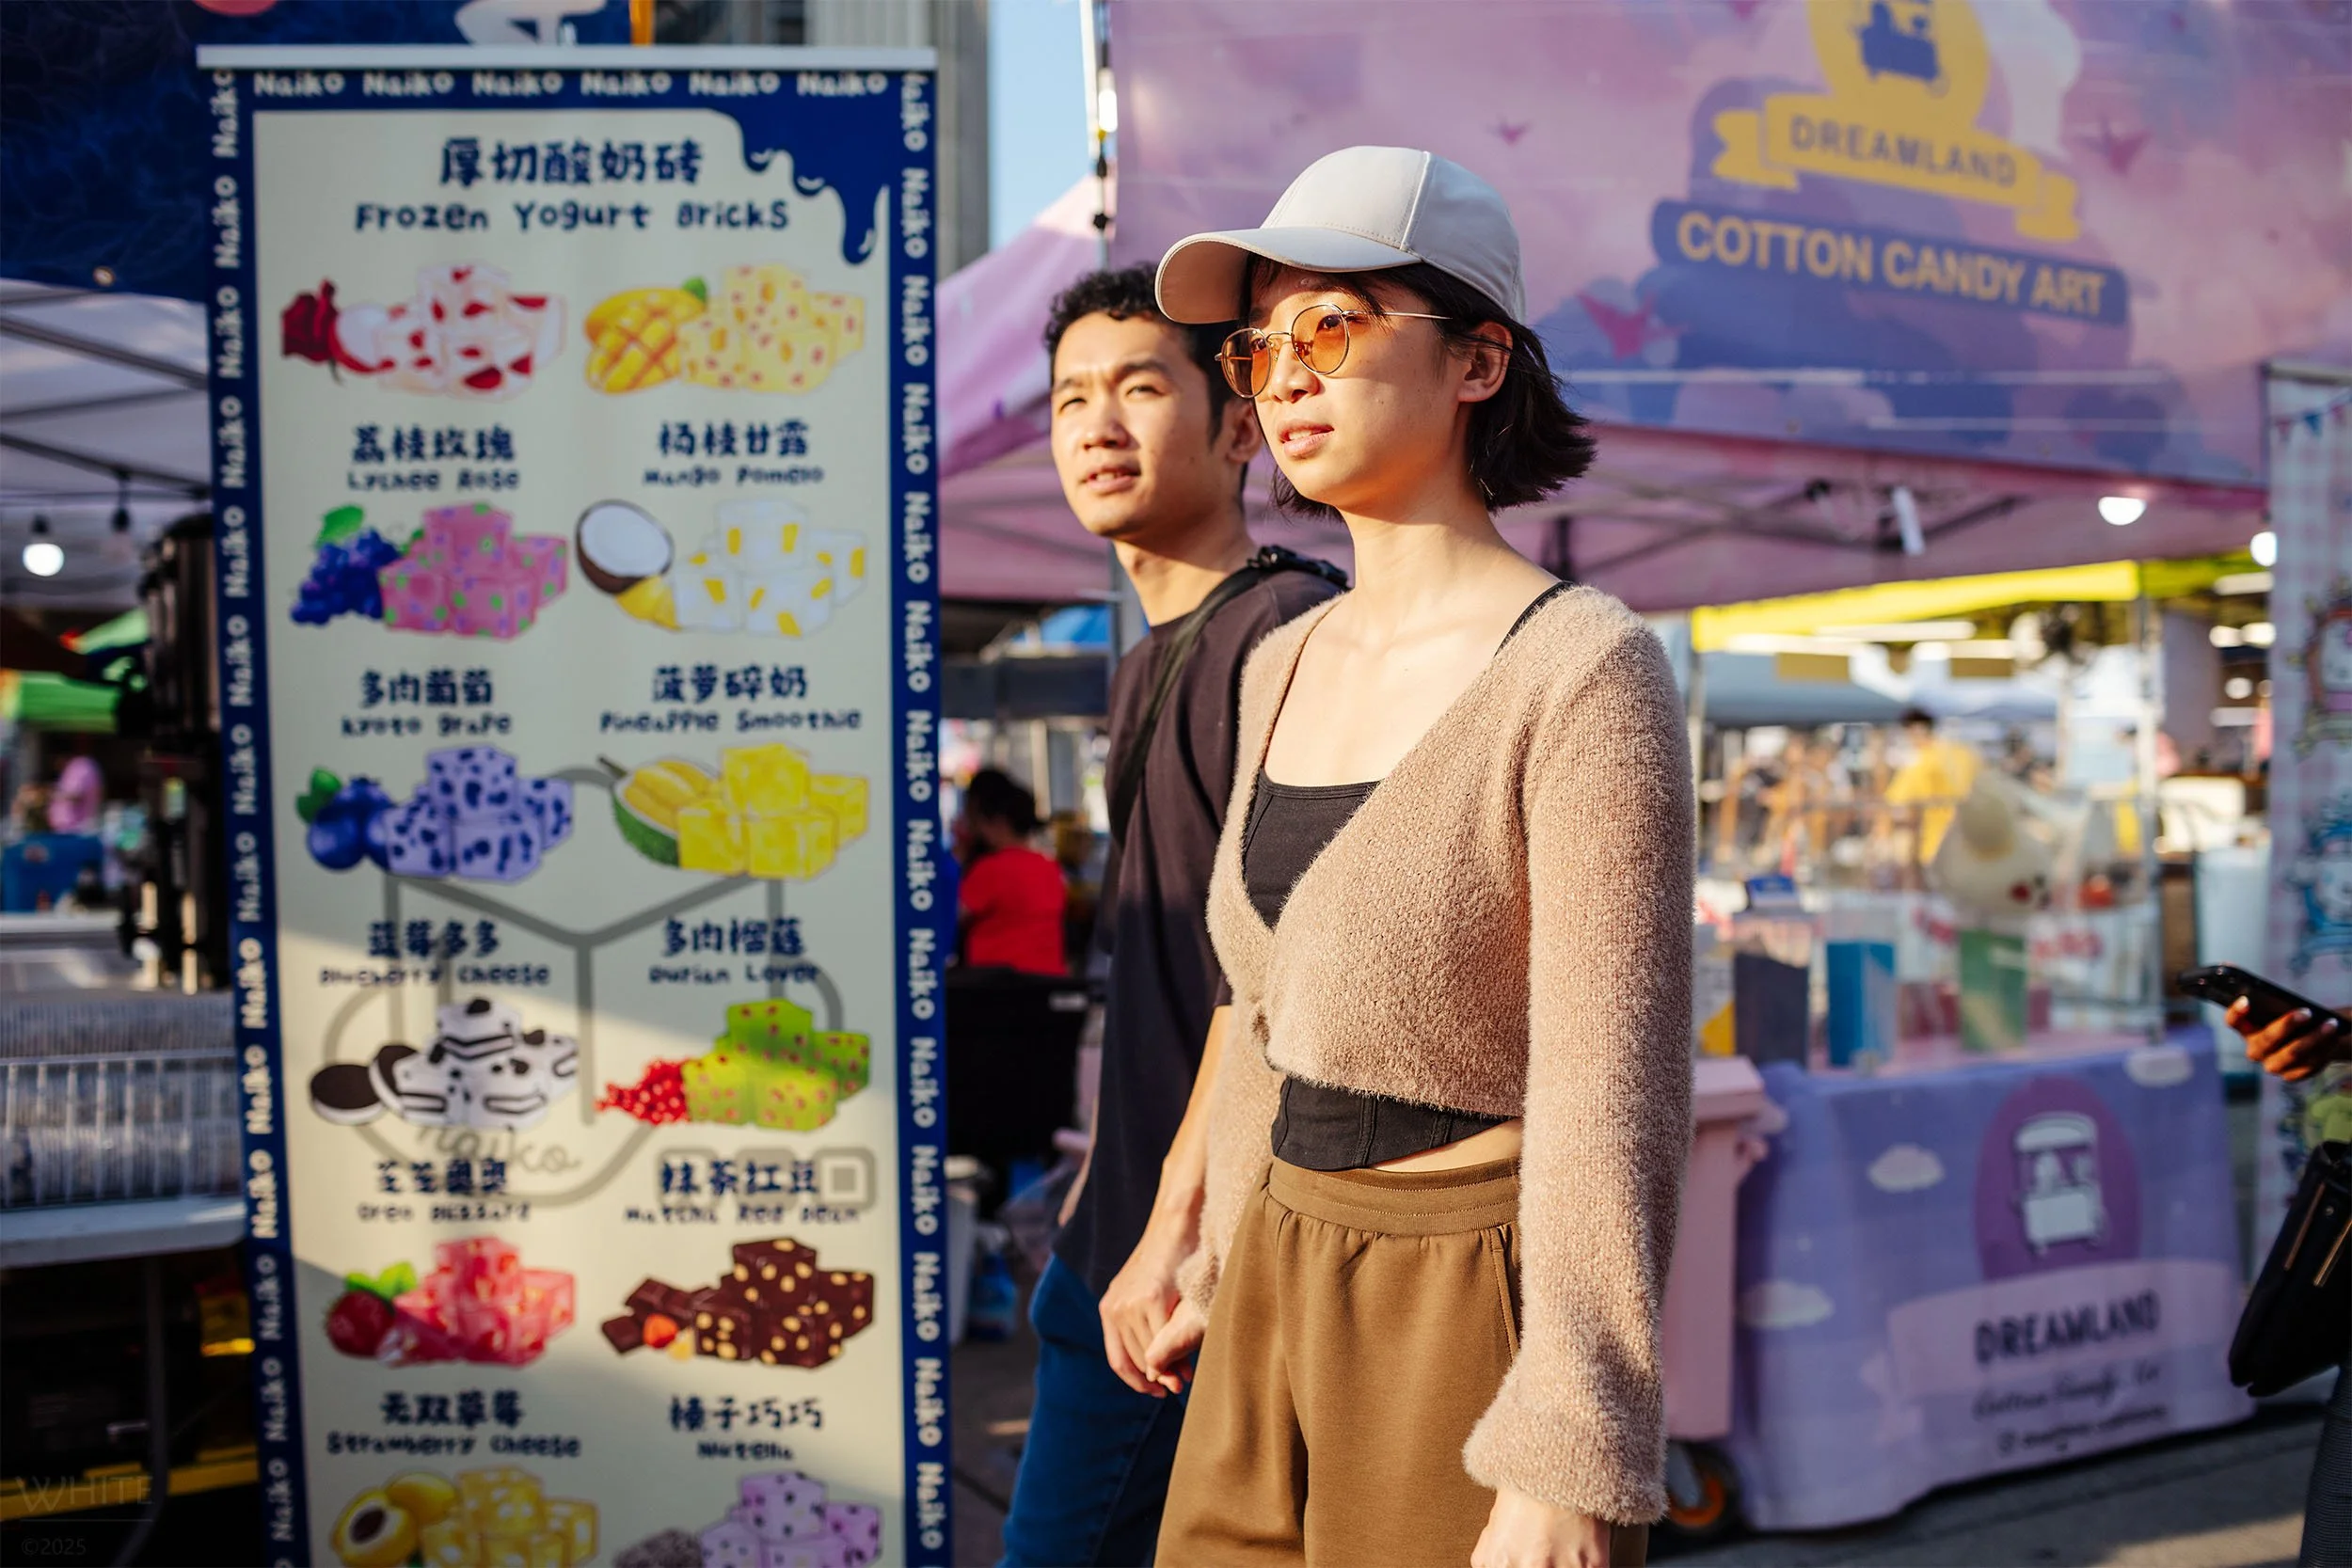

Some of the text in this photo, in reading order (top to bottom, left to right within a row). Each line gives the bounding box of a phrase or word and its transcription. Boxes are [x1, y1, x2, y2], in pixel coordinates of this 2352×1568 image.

[254, 71, 887, 97] Naiko Naiko Naiko Naiko Naiko Naiko
[439, 135, 703, 188] 厚切酸奶砖
[1792, 117, 2016, 186] DREAMLAND
[213, 175, 243, 268] Naiko
[355, 202, 489, 232] Frozen
[513, 199, 650, 231] Yogurt
[900, 167, 930, 259] Naiko
[1677, 211, 2106, 317] COTTON CANDY ART
[215, 286, 245, 378] Naiko
[901, 275, 931, 366] Naiko
[219, 396, 248, 488] Naiko
[659, 419, 810, 458] 杨枝甘露
[902, 383, 931, 475] Naiko
[223, 505, 251, 597] Naiko
[903, 491, 932, 583] Naiko
[227, 615, 255, 706] Naiko
[360, 668, 494, 709] 多肉葡萄
[653, 663, 809, 704] 菠萝碎奶
[904, 600, 934, 693] Naiko
[230, 723, 258, 815] Naiko
[905, 710, 934, 802] Naiko
[234, 832, 262, 922] Naiko
[906, 819, 936, 911] Naiko
[662, 915, 806, 958] 多肉榴莲
[908, 928, 938, 1020] Naiko
[238, 938, 268, 1029] Naiko
[243, 1045, 274, 1134] Naiko
[910, 1037, 939, 1128] Naiko
[247, 1149, 279, 1239] Naiko
[911, 1145, 941, 1236] Naiko
[253, 1255, 283, 1341] Naiko
[913, 1252, 943, 1341] Naiko
[1976, 1290, 2158, 1363] DREAMLAND
[260, 1356, 289, 1442] Naiko
[914, 1357, 944, 1447] Naiko
[265, 1457, 294, 1542] Naiko
[916, 1462, 946, 1549] Naiko
